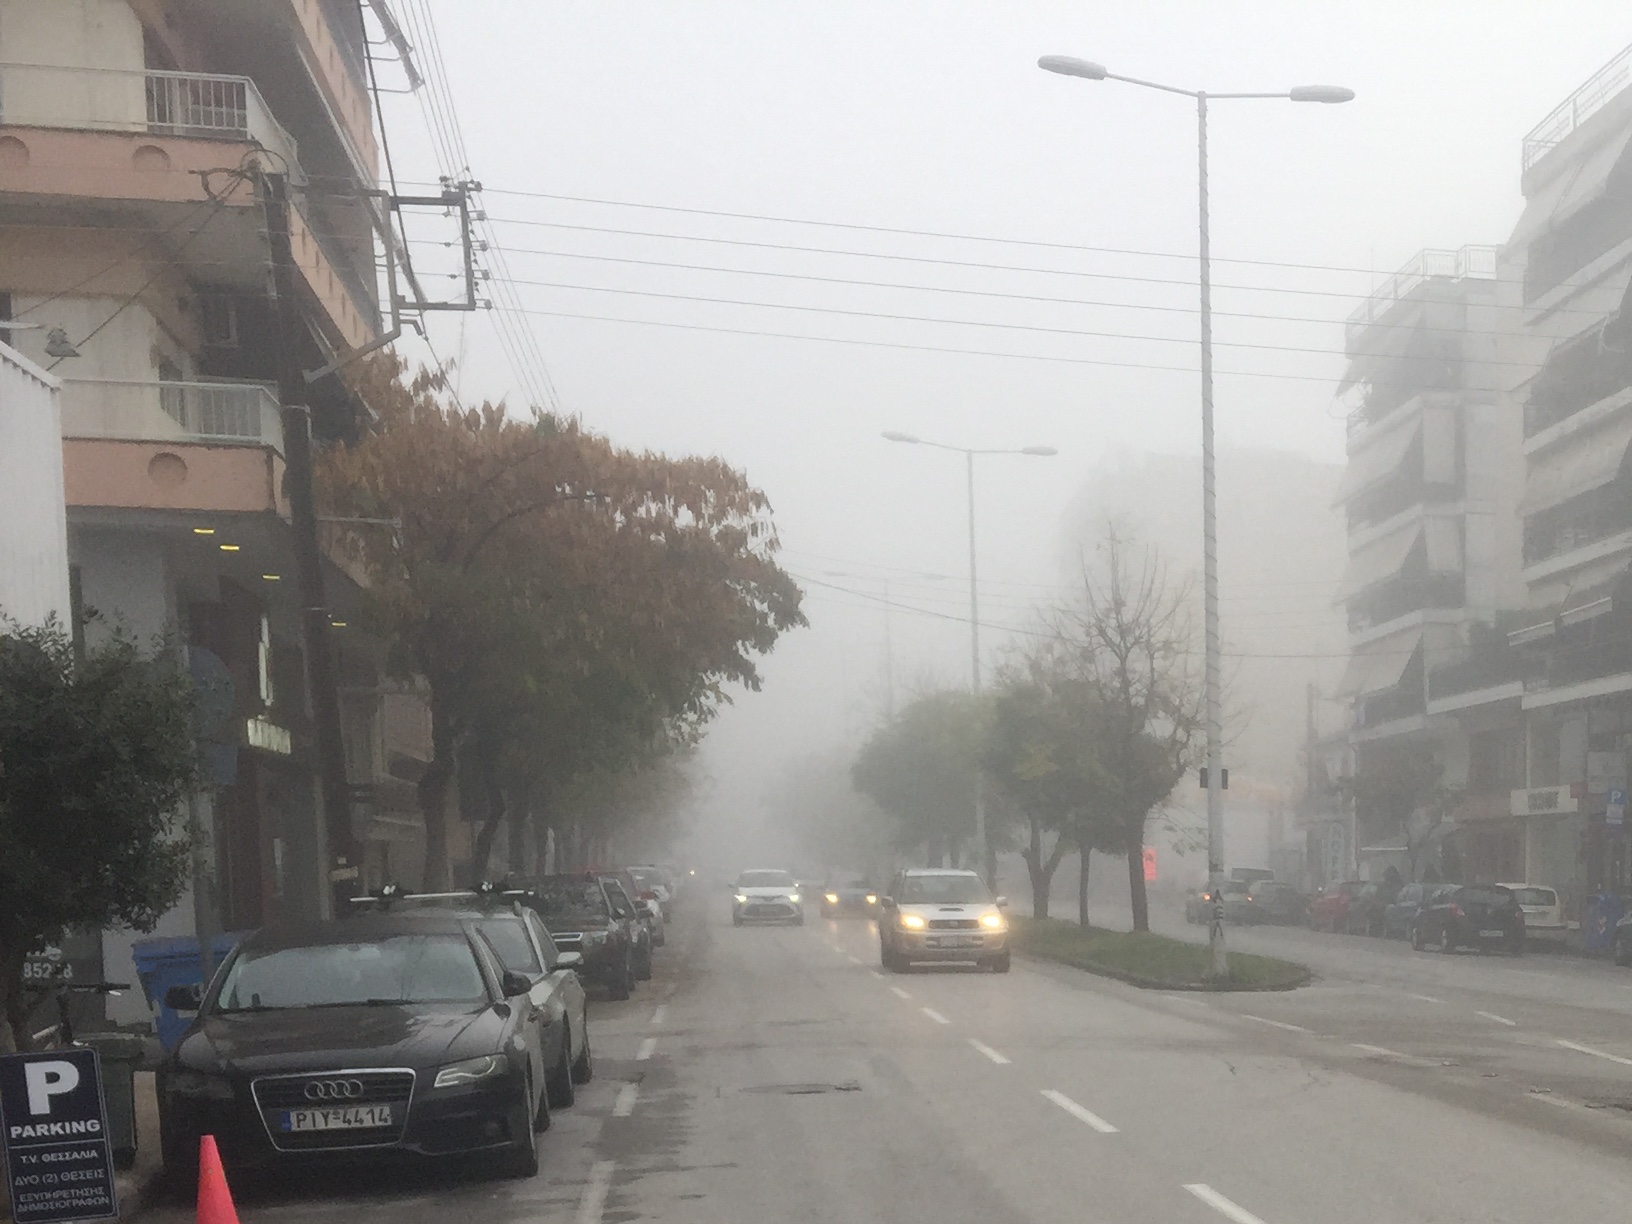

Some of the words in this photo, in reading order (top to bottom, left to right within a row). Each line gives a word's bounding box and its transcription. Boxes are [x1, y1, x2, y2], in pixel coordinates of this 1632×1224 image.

[24, 1060, 80, 1116] P
[10, 1118, 101, 1139] PARKING
[41, 1149, 99, 1163] ΘΕΣΣΑΛΙΑ
[14, 1174, 40, 1187] ΔΥΟ
[42, 1173, 58, 1186] (2)
[60, 1168, 105, 1182] ΘΕΣΕΙΣ
